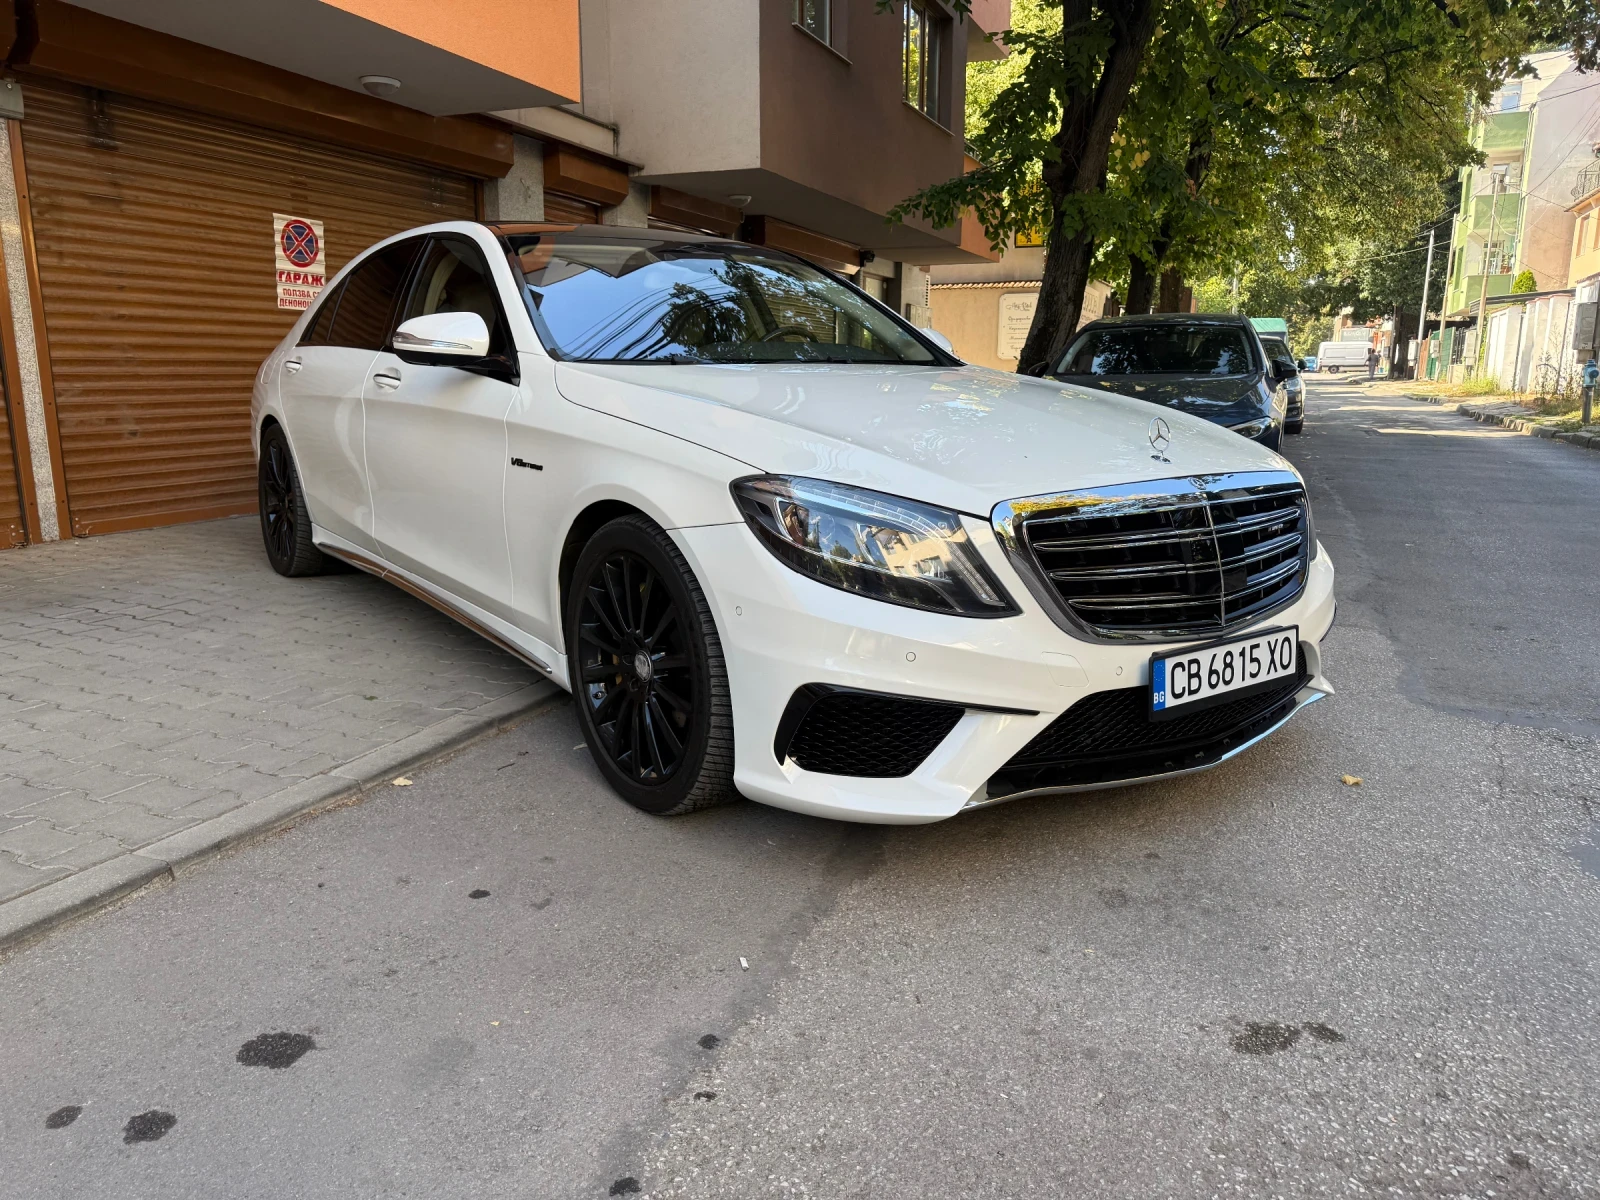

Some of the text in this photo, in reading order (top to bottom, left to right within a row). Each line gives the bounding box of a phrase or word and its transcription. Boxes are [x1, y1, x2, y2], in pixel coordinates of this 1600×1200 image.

[278, 270, 324, 286] ГАРАЖ
[282, 287, 311, 299] ПОЛЗВА
[1207, 643, 1262, 690] 6815
[1153, 691, 1165, 704] BG
